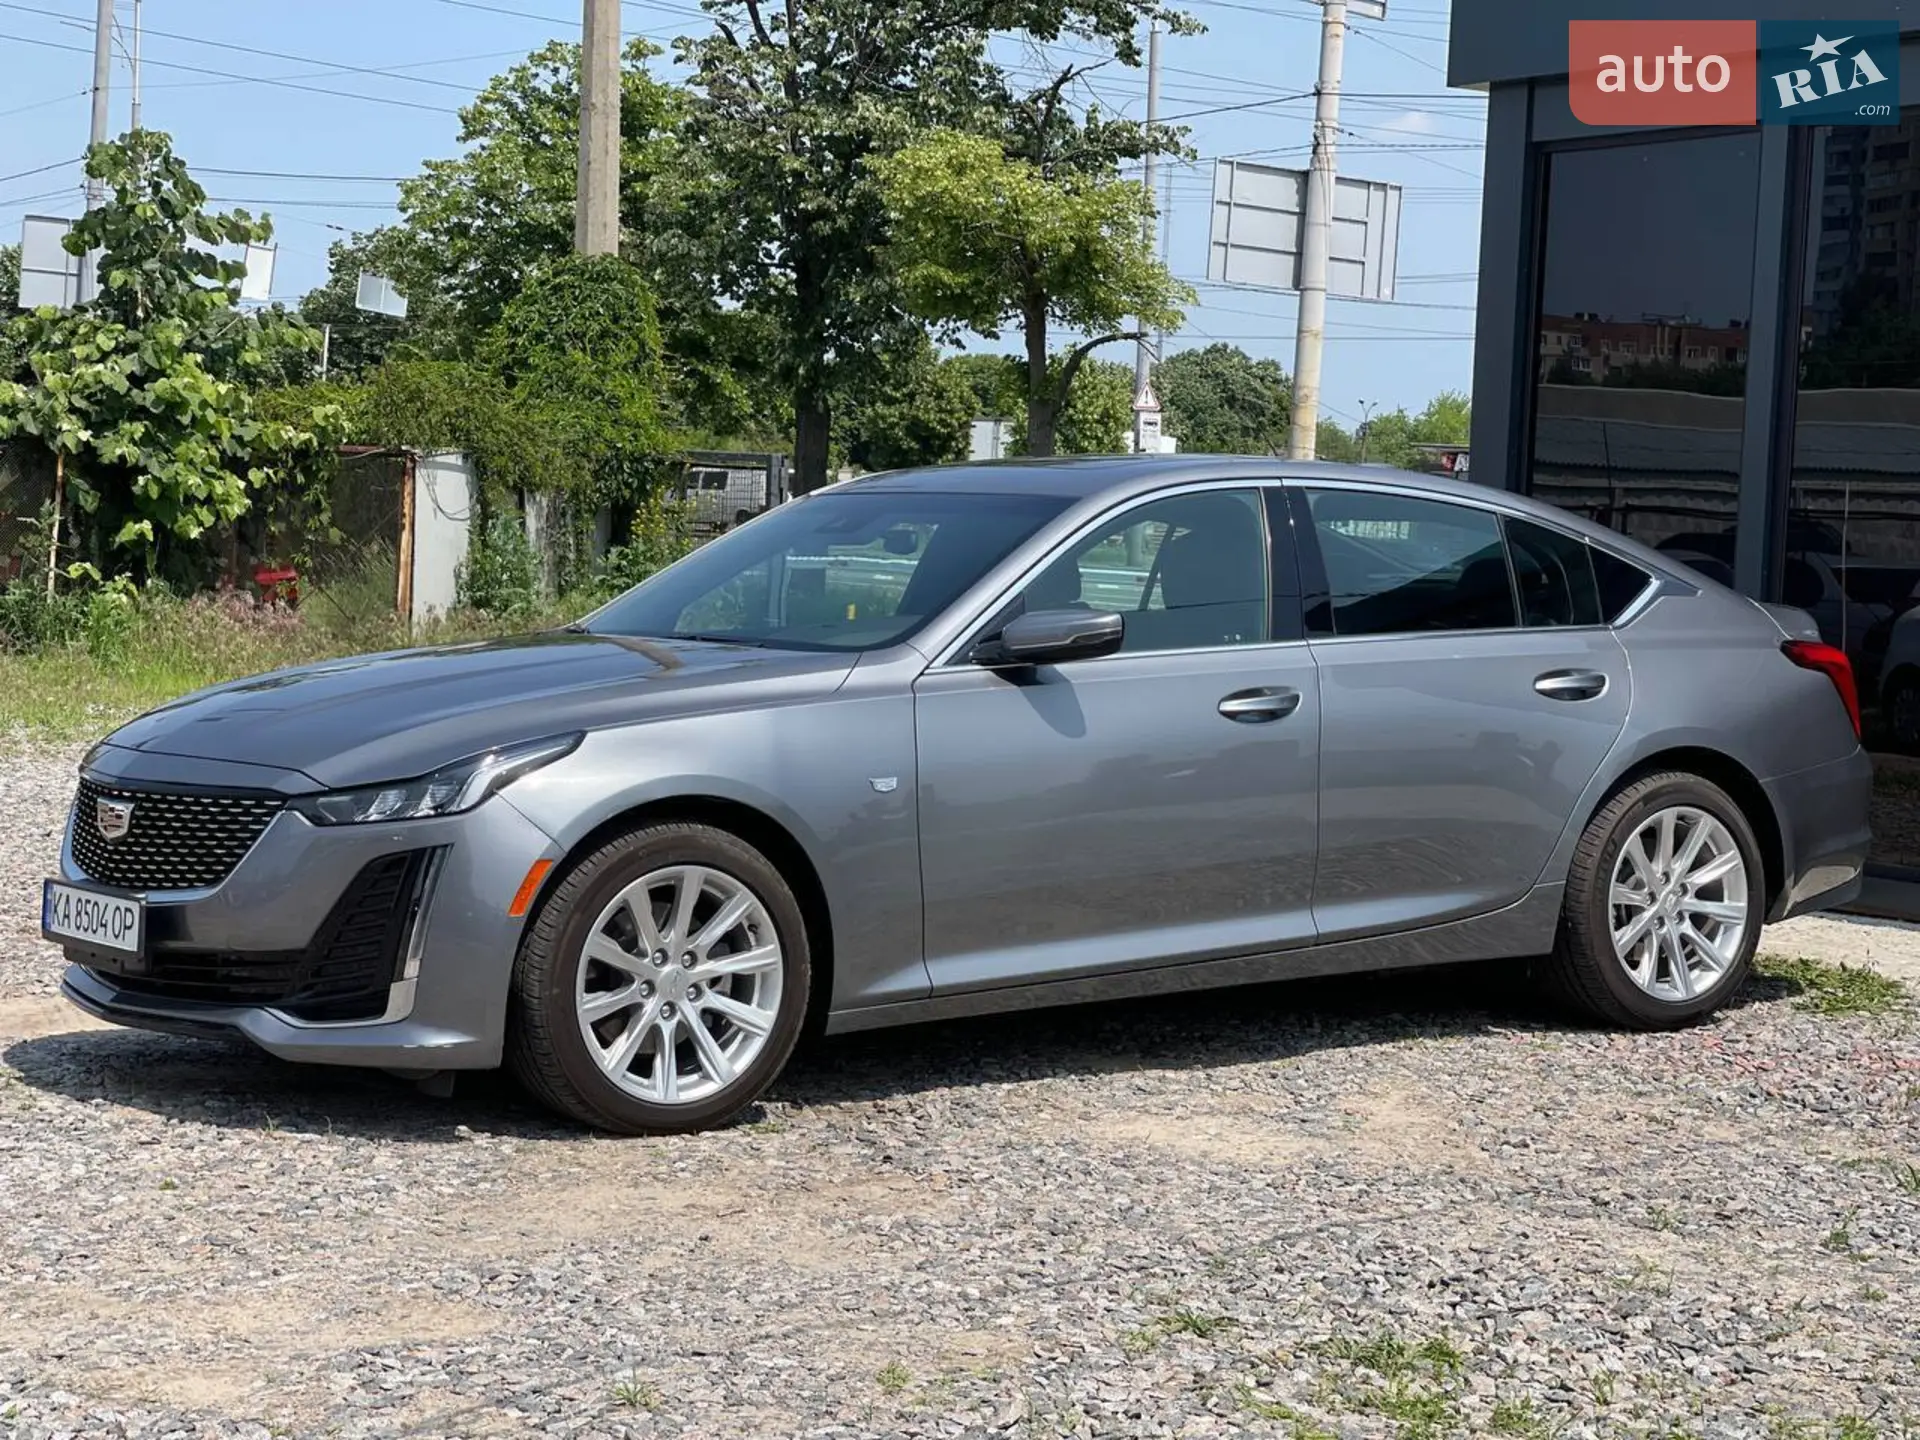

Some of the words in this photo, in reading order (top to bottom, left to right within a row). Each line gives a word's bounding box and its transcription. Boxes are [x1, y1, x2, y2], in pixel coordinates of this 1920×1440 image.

[52, 891, 71, 929] KA
[74, 897, 109, 938] 8504
[111, 905, 135, 942] OP
